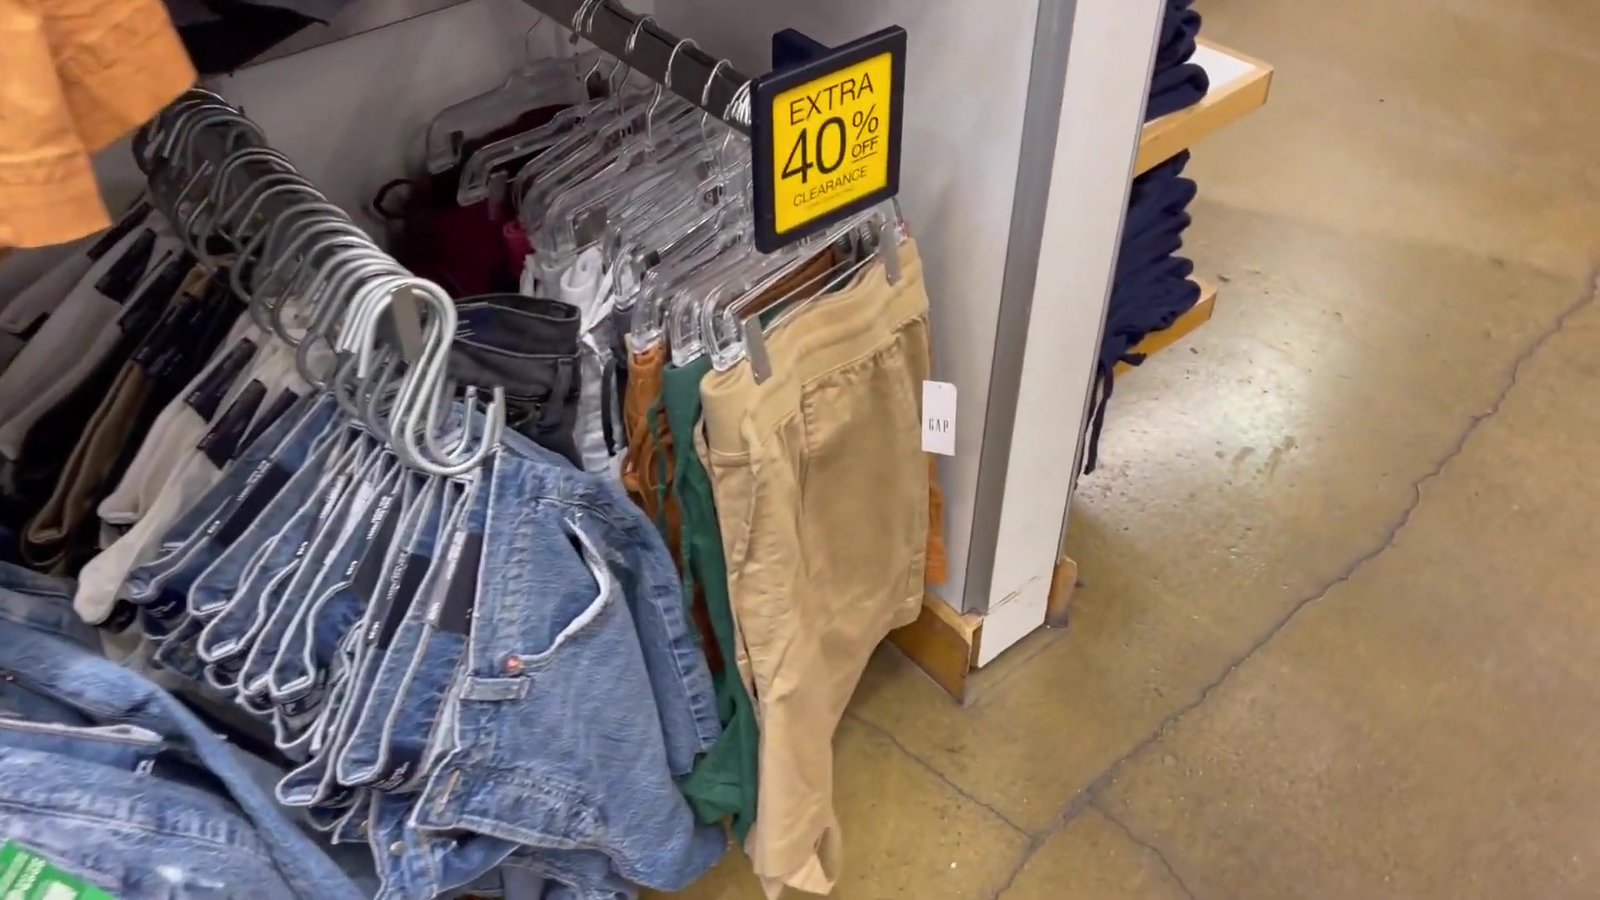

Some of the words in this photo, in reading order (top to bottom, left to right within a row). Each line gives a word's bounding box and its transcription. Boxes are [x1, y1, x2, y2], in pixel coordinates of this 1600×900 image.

[790, 72, 874, 126] EXTRA
[851, 135, 879, 158] OFF
[793, 165, 868, 207] CLEARANCE
[928, 417, 949, 433] GAP
